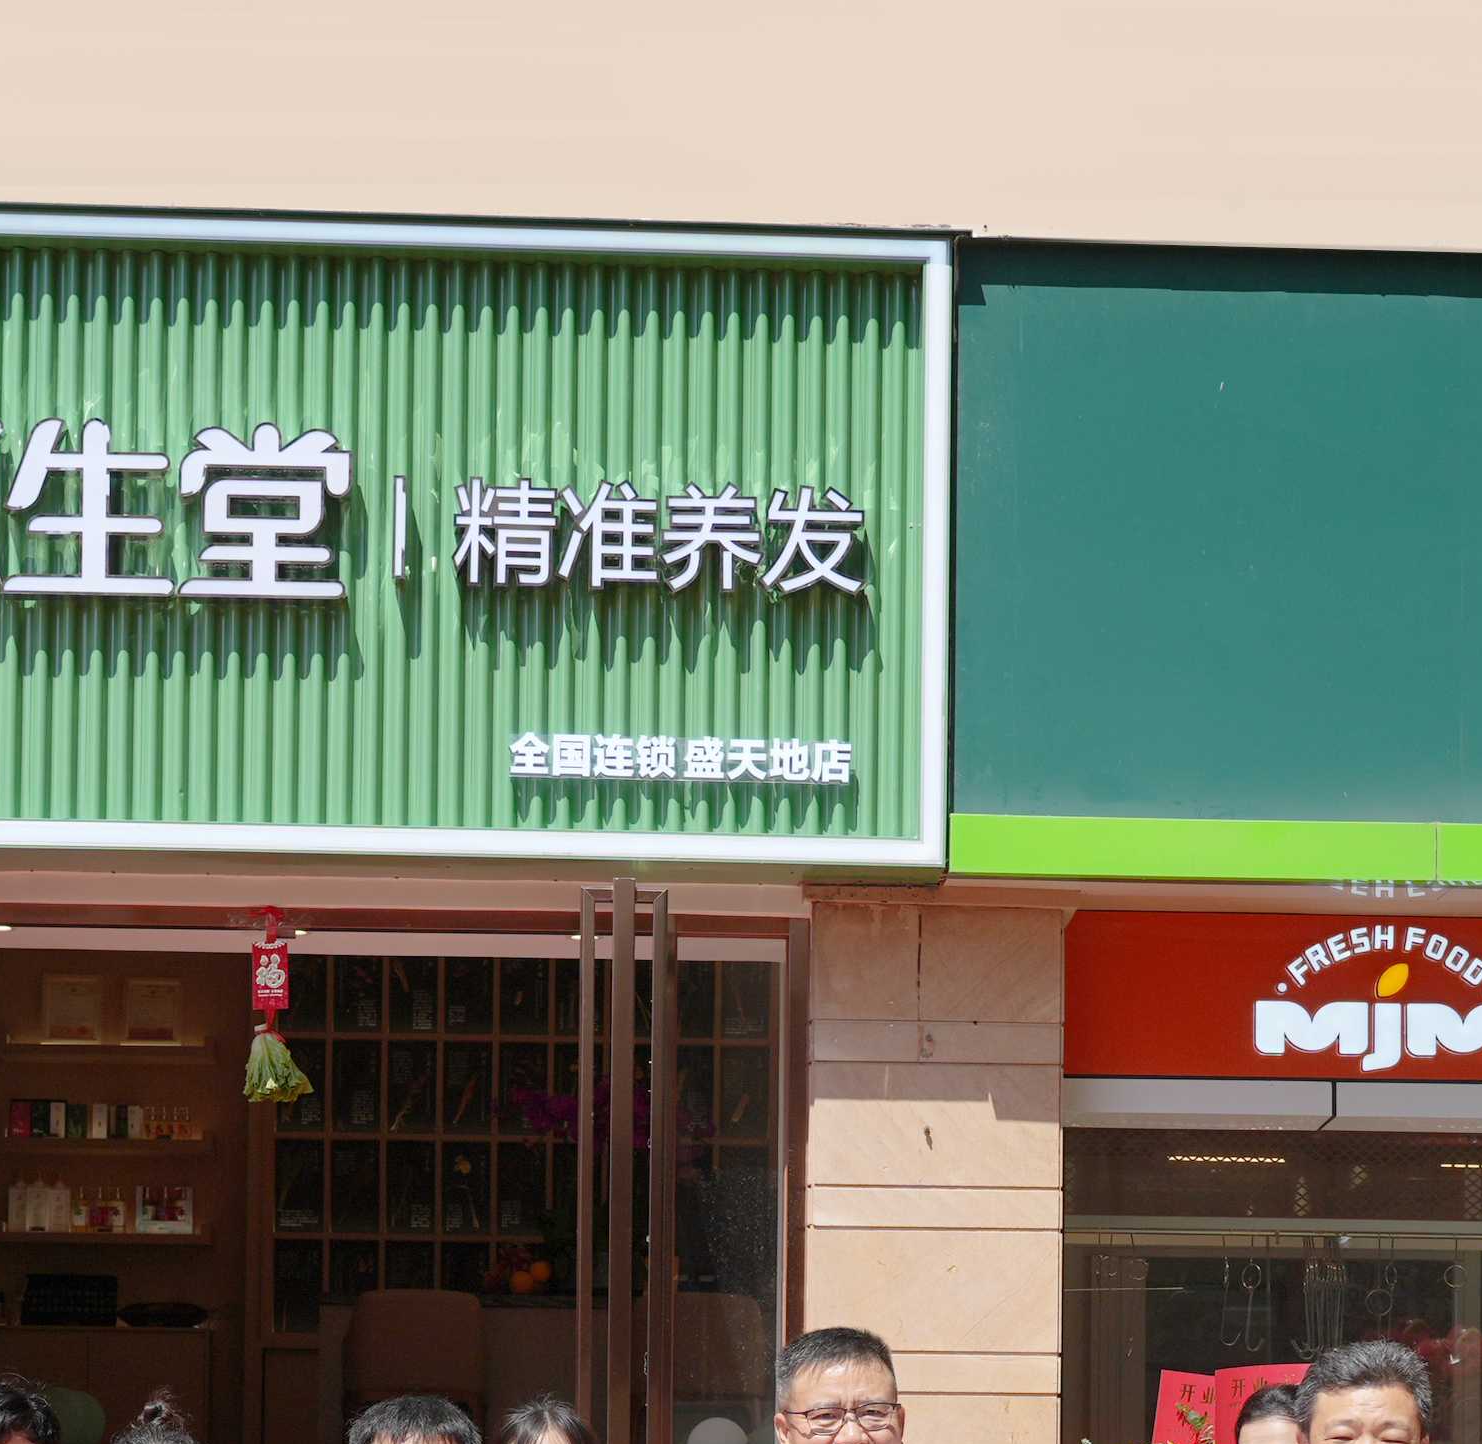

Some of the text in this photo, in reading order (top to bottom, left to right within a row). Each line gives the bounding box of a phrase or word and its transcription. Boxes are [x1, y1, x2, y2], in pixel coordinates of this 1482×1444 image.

[453, 477, 865, 596] 精准养发
[256, 954, 286, 989] 福
[1285, 924, 1395, 988] FRESH
